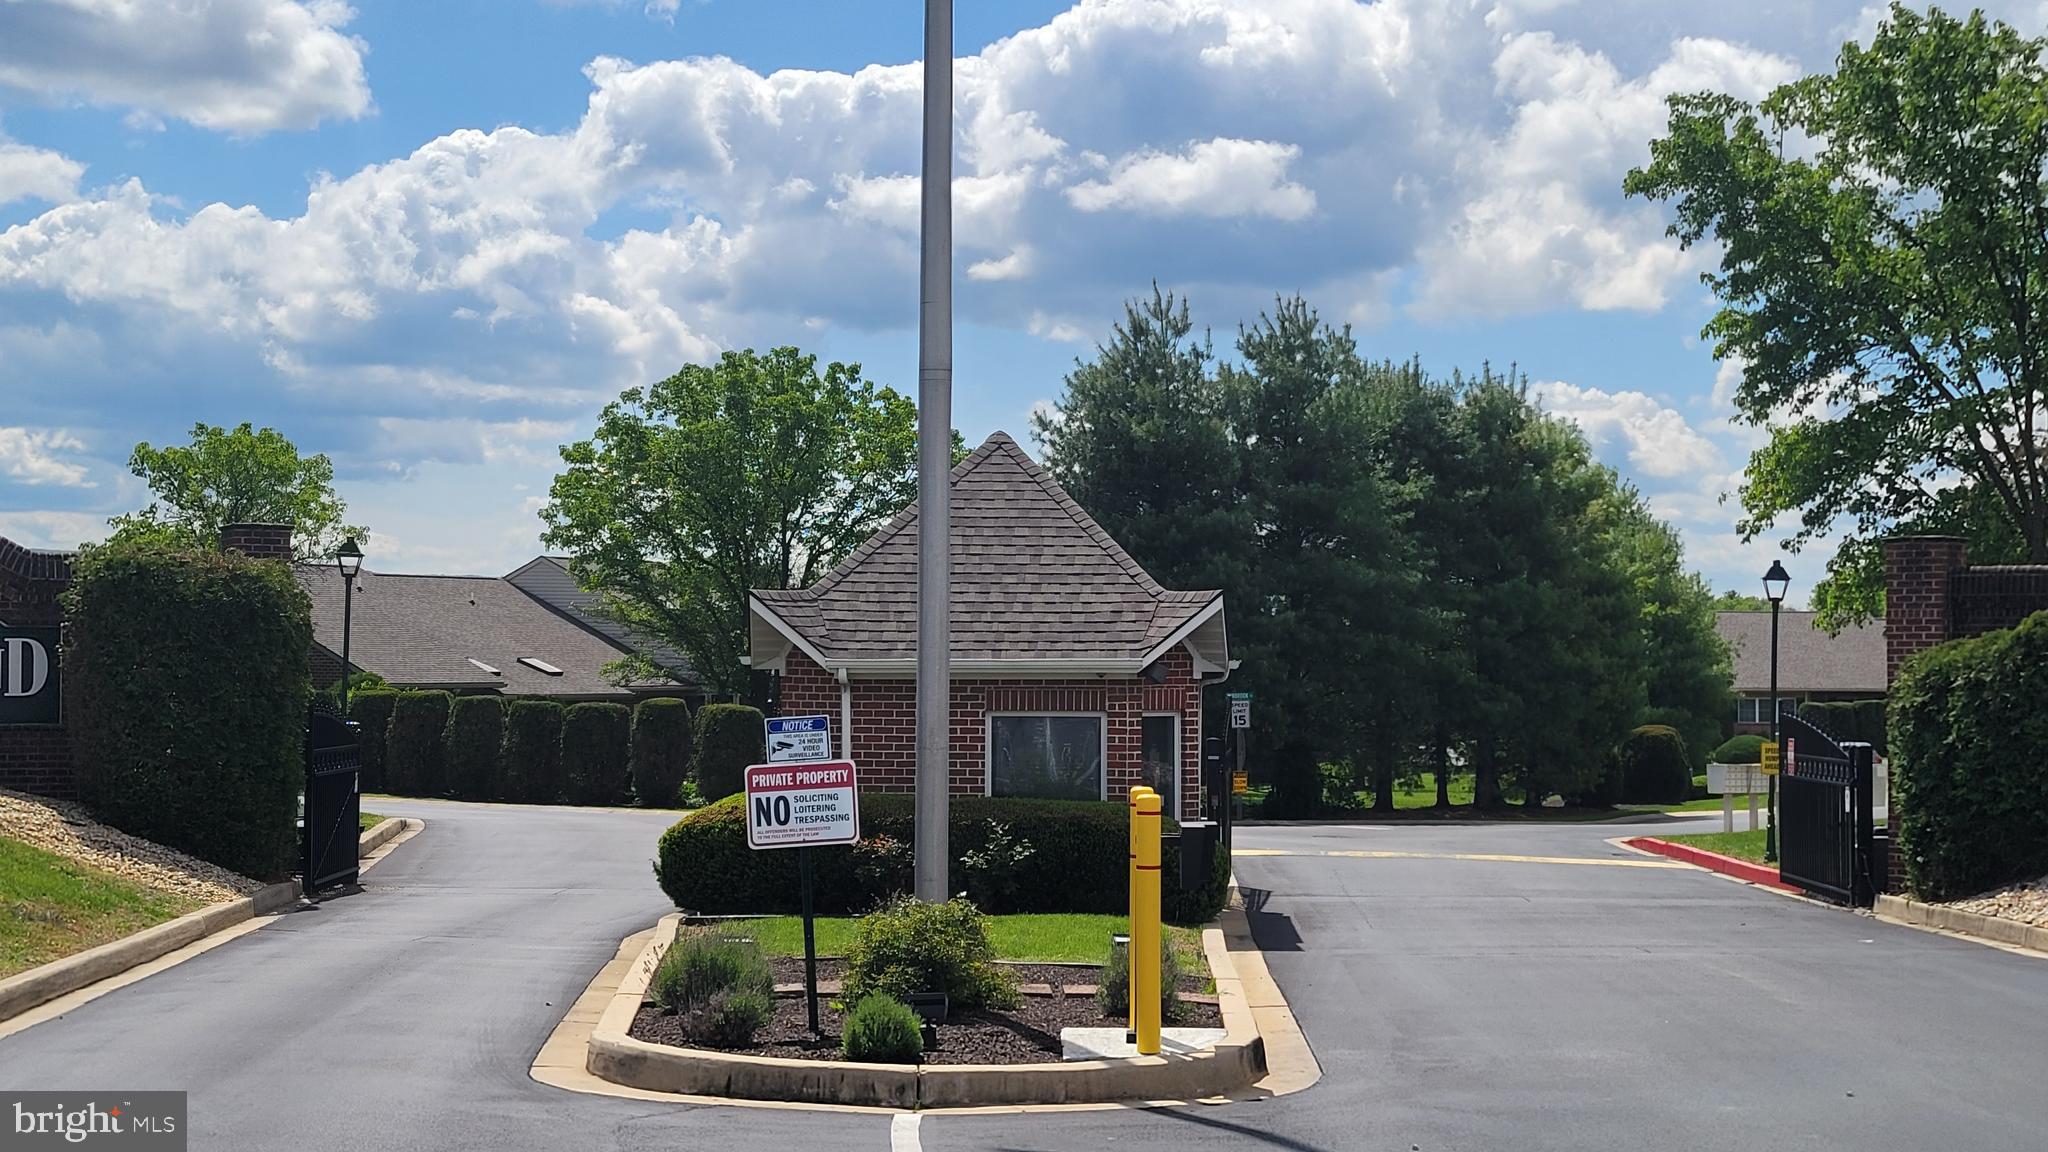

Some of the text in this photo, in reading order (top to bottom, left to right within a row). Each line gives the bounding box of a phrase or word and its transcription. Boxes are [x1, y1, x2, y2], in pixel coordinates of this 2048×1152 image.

[0, 637, 48, 696] D
[782, 720, 814, 730] NOTICE
[1234, 715, 1246, 725] 15
[752, 770, 848, 787] PRIVATE PROPERTY
[794, 793, 838, 803] SOLICITING
[755, 795, 790, 827] NO
[794, 804, 836, 813] LOITERING
[794, 814, 850, 824] TRESPASSING
